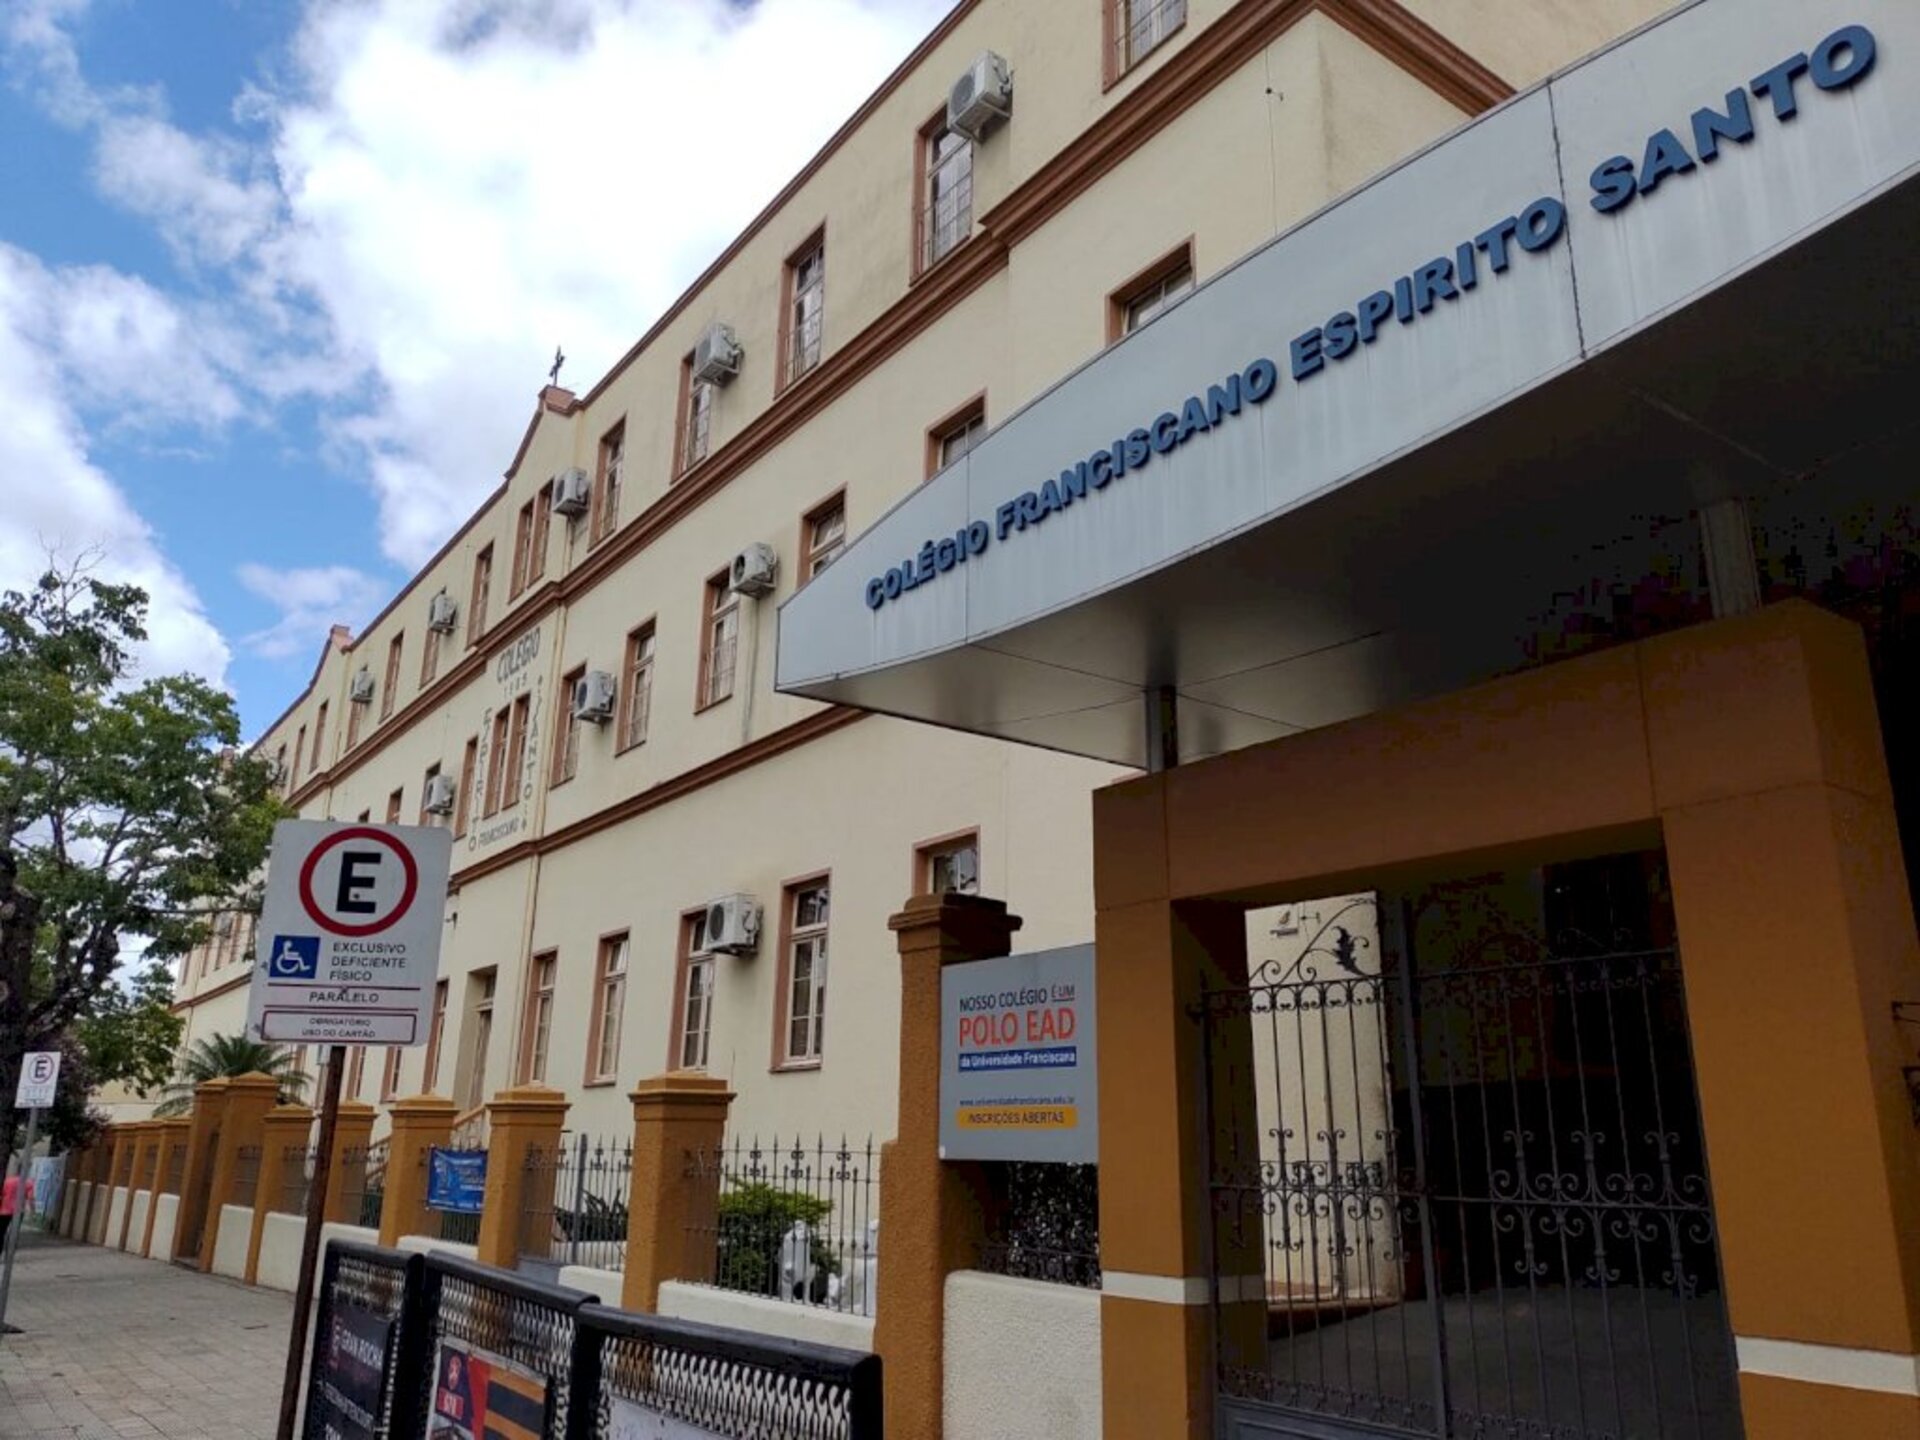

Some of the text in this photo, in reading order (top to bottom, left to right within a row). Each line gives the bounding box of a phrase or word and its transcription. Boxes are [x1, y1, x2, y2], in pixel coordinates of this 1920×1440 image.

[865, 24, 1877, 610] COLÉGIO FRANCISCANO ESPIRITO SANTO
[336, 851, 382, 914] E
[332, 942, 406, 954] EXCLUSIVO
[331, 955, 407, 968] DEFICIENTE
[329, 970, 372, 982] FÍSICO
[308, 991, 380, 1003] PARALELO
[959, 994, 996, 1012] NOSSO
[998, 987, 1048, 1007] COLÉGIO
[1058, 985, 1076, 998] UM
[302, 1028, 376, 1038] USO DO CARTÃO
[959, 1007, 1076, 1047] POLO EAD
[971, 1053, 1023, 1067] Universidade
[1023, 1050, 1076, 1064] Franciscana
[35, 1060, 48, 1078] E
[967, 1110, 1065, 1125] INSCRIÇÕES ABERTAS
